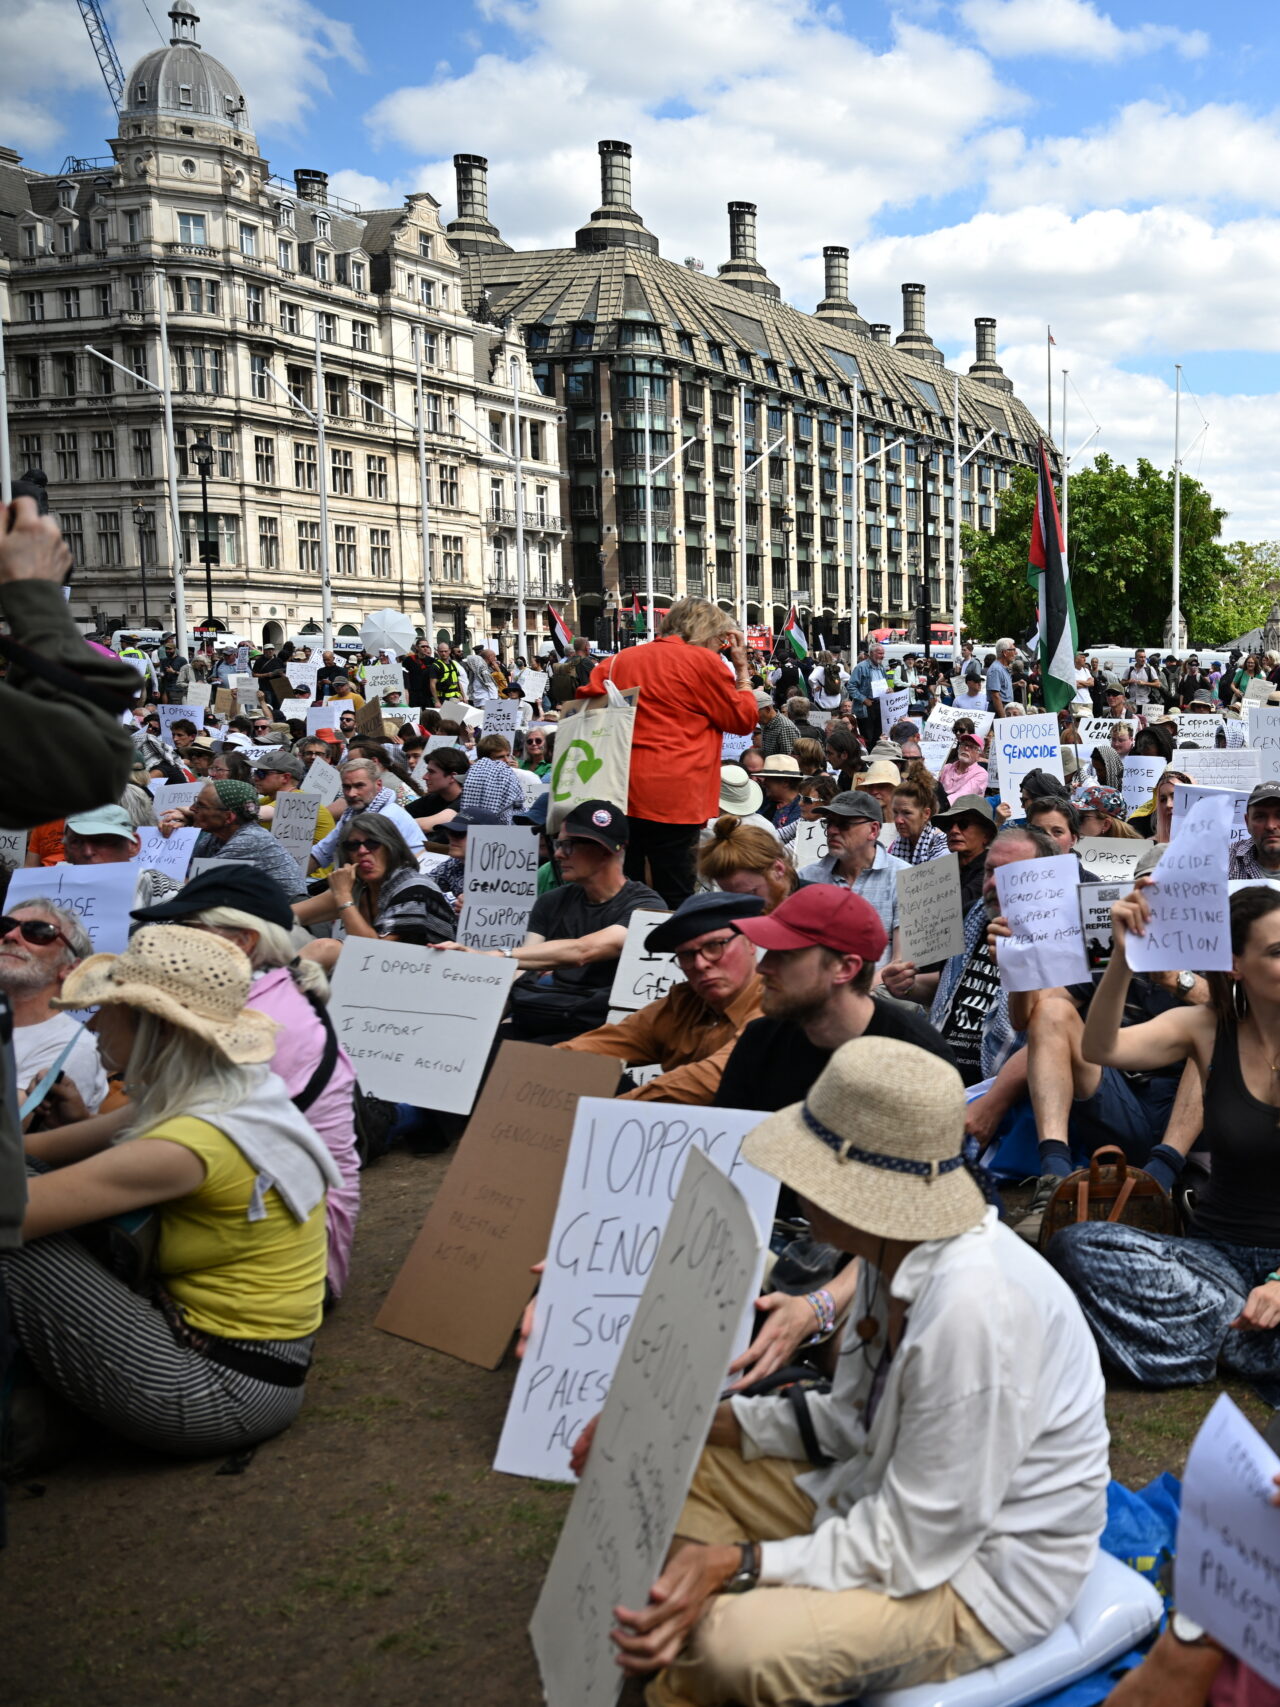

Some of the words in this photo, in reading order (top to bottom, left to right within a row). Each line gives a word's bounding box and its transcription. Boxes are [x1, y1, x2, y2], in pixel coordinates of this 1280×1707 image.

[368, 679, 399, 687] GENOCIDE
[169, 708, 198, 718] OPPOSE
[938, 707, 950, 715] WE
[952, 710, 987, 720] OPPOSE
[1010, 723, 1056, 739] OPPOSE
[1084, 720, 1093, 731] I
[1178, 715, 1185, 726] I
[1187, 718, 1221, 730] oppose
[721, 741, 747, 750] ENOCIDE
[1002, 743, 1058, 765] GENOCIDE
[1198, 775, 1243, 785] ENOCIDE
[805, 826, 816, 841] I
[471, 837, 476, 873] I
[480, 841, 537, 872] OPPOSE
[1085, 848, 1137, 865] OPPOSE
[58, 873, 64, 894] I
[1010, 869, 1056, 887] OPPOSE
[468, 878, 536, 896] GENOCIDE
[1152, 881, 1220, 897] SUPPORT
[464, 906, 472, 931] I
[1014, 908, 1059, 926] SUPPORT
[1150, 907, 1224, 924] ALESTINE
[461, 932, 526, 949] PALESTIN
[1147, 930, 1219, 954] ACTION
[360, 955, 376, 973] I
[381, 959, 433, 975] OPPOSE
[442, 968, 503, 986] GENOCIDE
[341, 1017, 355, 1032] I
[362, 1020, 425, 1037] SUPPORT
[414, 1058, 466, 1074] ACTION
[582, 1118, 597, 1190] I
[556, 1212, 661, 1277] GENO
[536, 1304, 553, 1362] I
[523, 1364, 614, 1413] PALES
